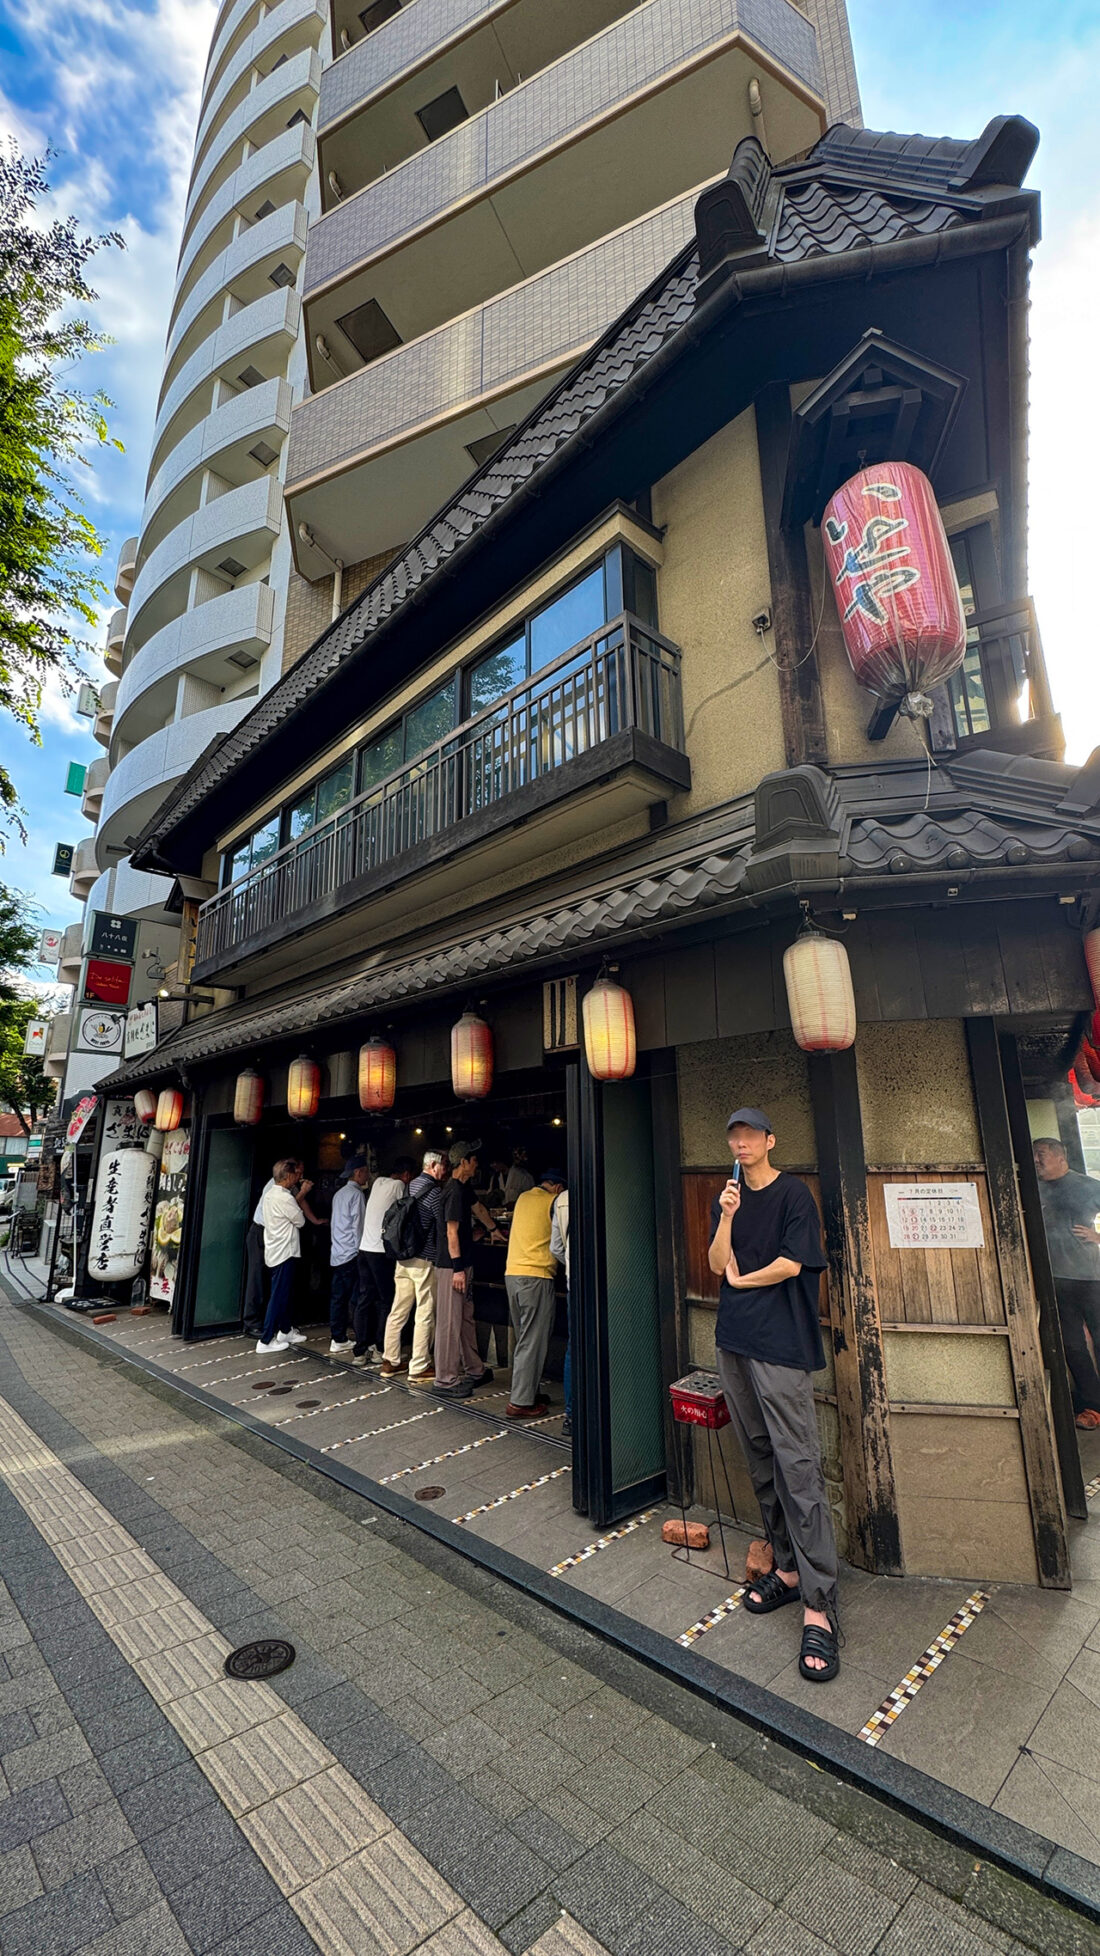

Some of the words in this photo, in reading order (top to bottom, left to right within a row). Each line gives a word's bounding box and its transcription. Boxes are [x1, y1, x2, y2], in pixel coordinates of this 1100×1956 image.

[93, 1159, 122, 1271] 生産者直営店
